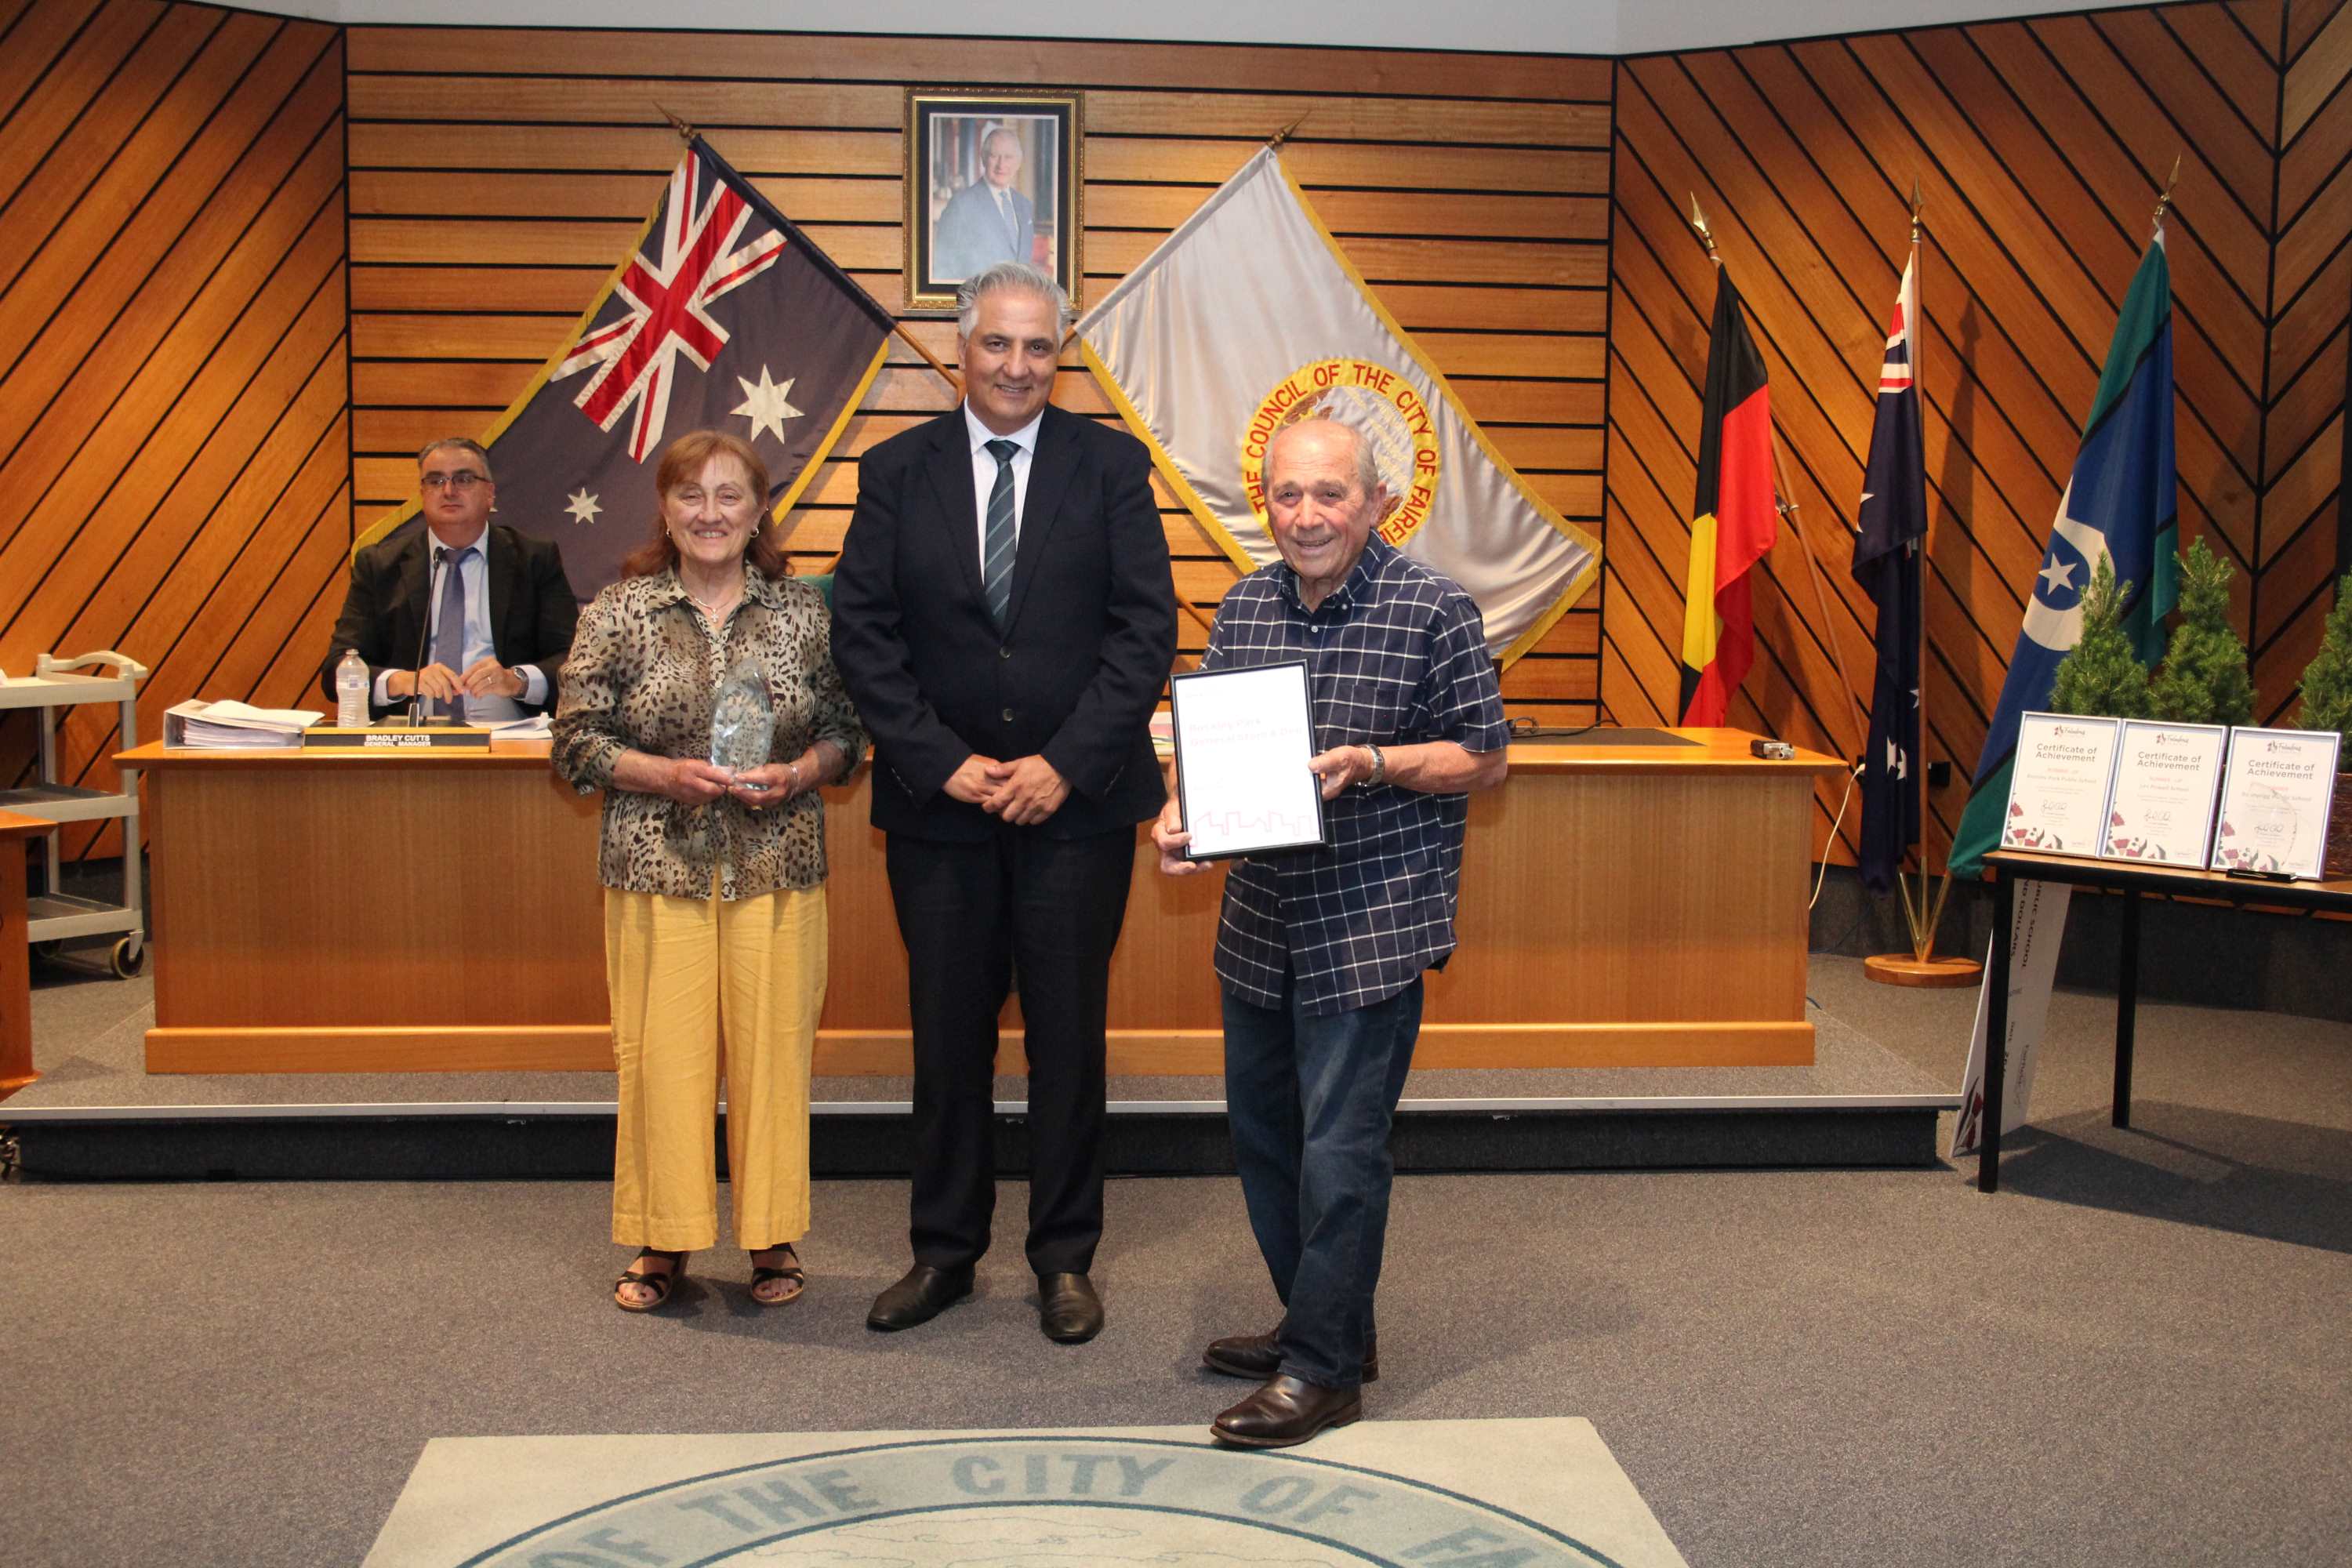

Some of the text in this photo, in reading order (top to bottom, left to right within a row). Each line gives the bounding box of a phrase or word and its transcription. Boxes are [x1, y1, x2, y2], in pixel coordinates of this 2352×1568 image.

[1247, 380, 1308, 459] COUNCIL
[1314, 364, 1341, 387] OF
[1353, 364, 1395, 394] THE
[1396, 390, 1432, 436] CITY
[1417, 449, 1436, 477] OF
[2037, 743, 2084, 753] Certificate
[2035, 752, 2095, 762] Achievement
[2138, 751, 2188, 762] Certificate
[2137, 760, 2200, 771] Achievement
[2249, 760, 2301, 771] Certificate
[2247, 768, 2313, 779] Achievement
[675, 1468, 880, 1534] THE
[952, 1454, 1176, 1496] CITY
[1240, 1475, 1379, 1523] OF
